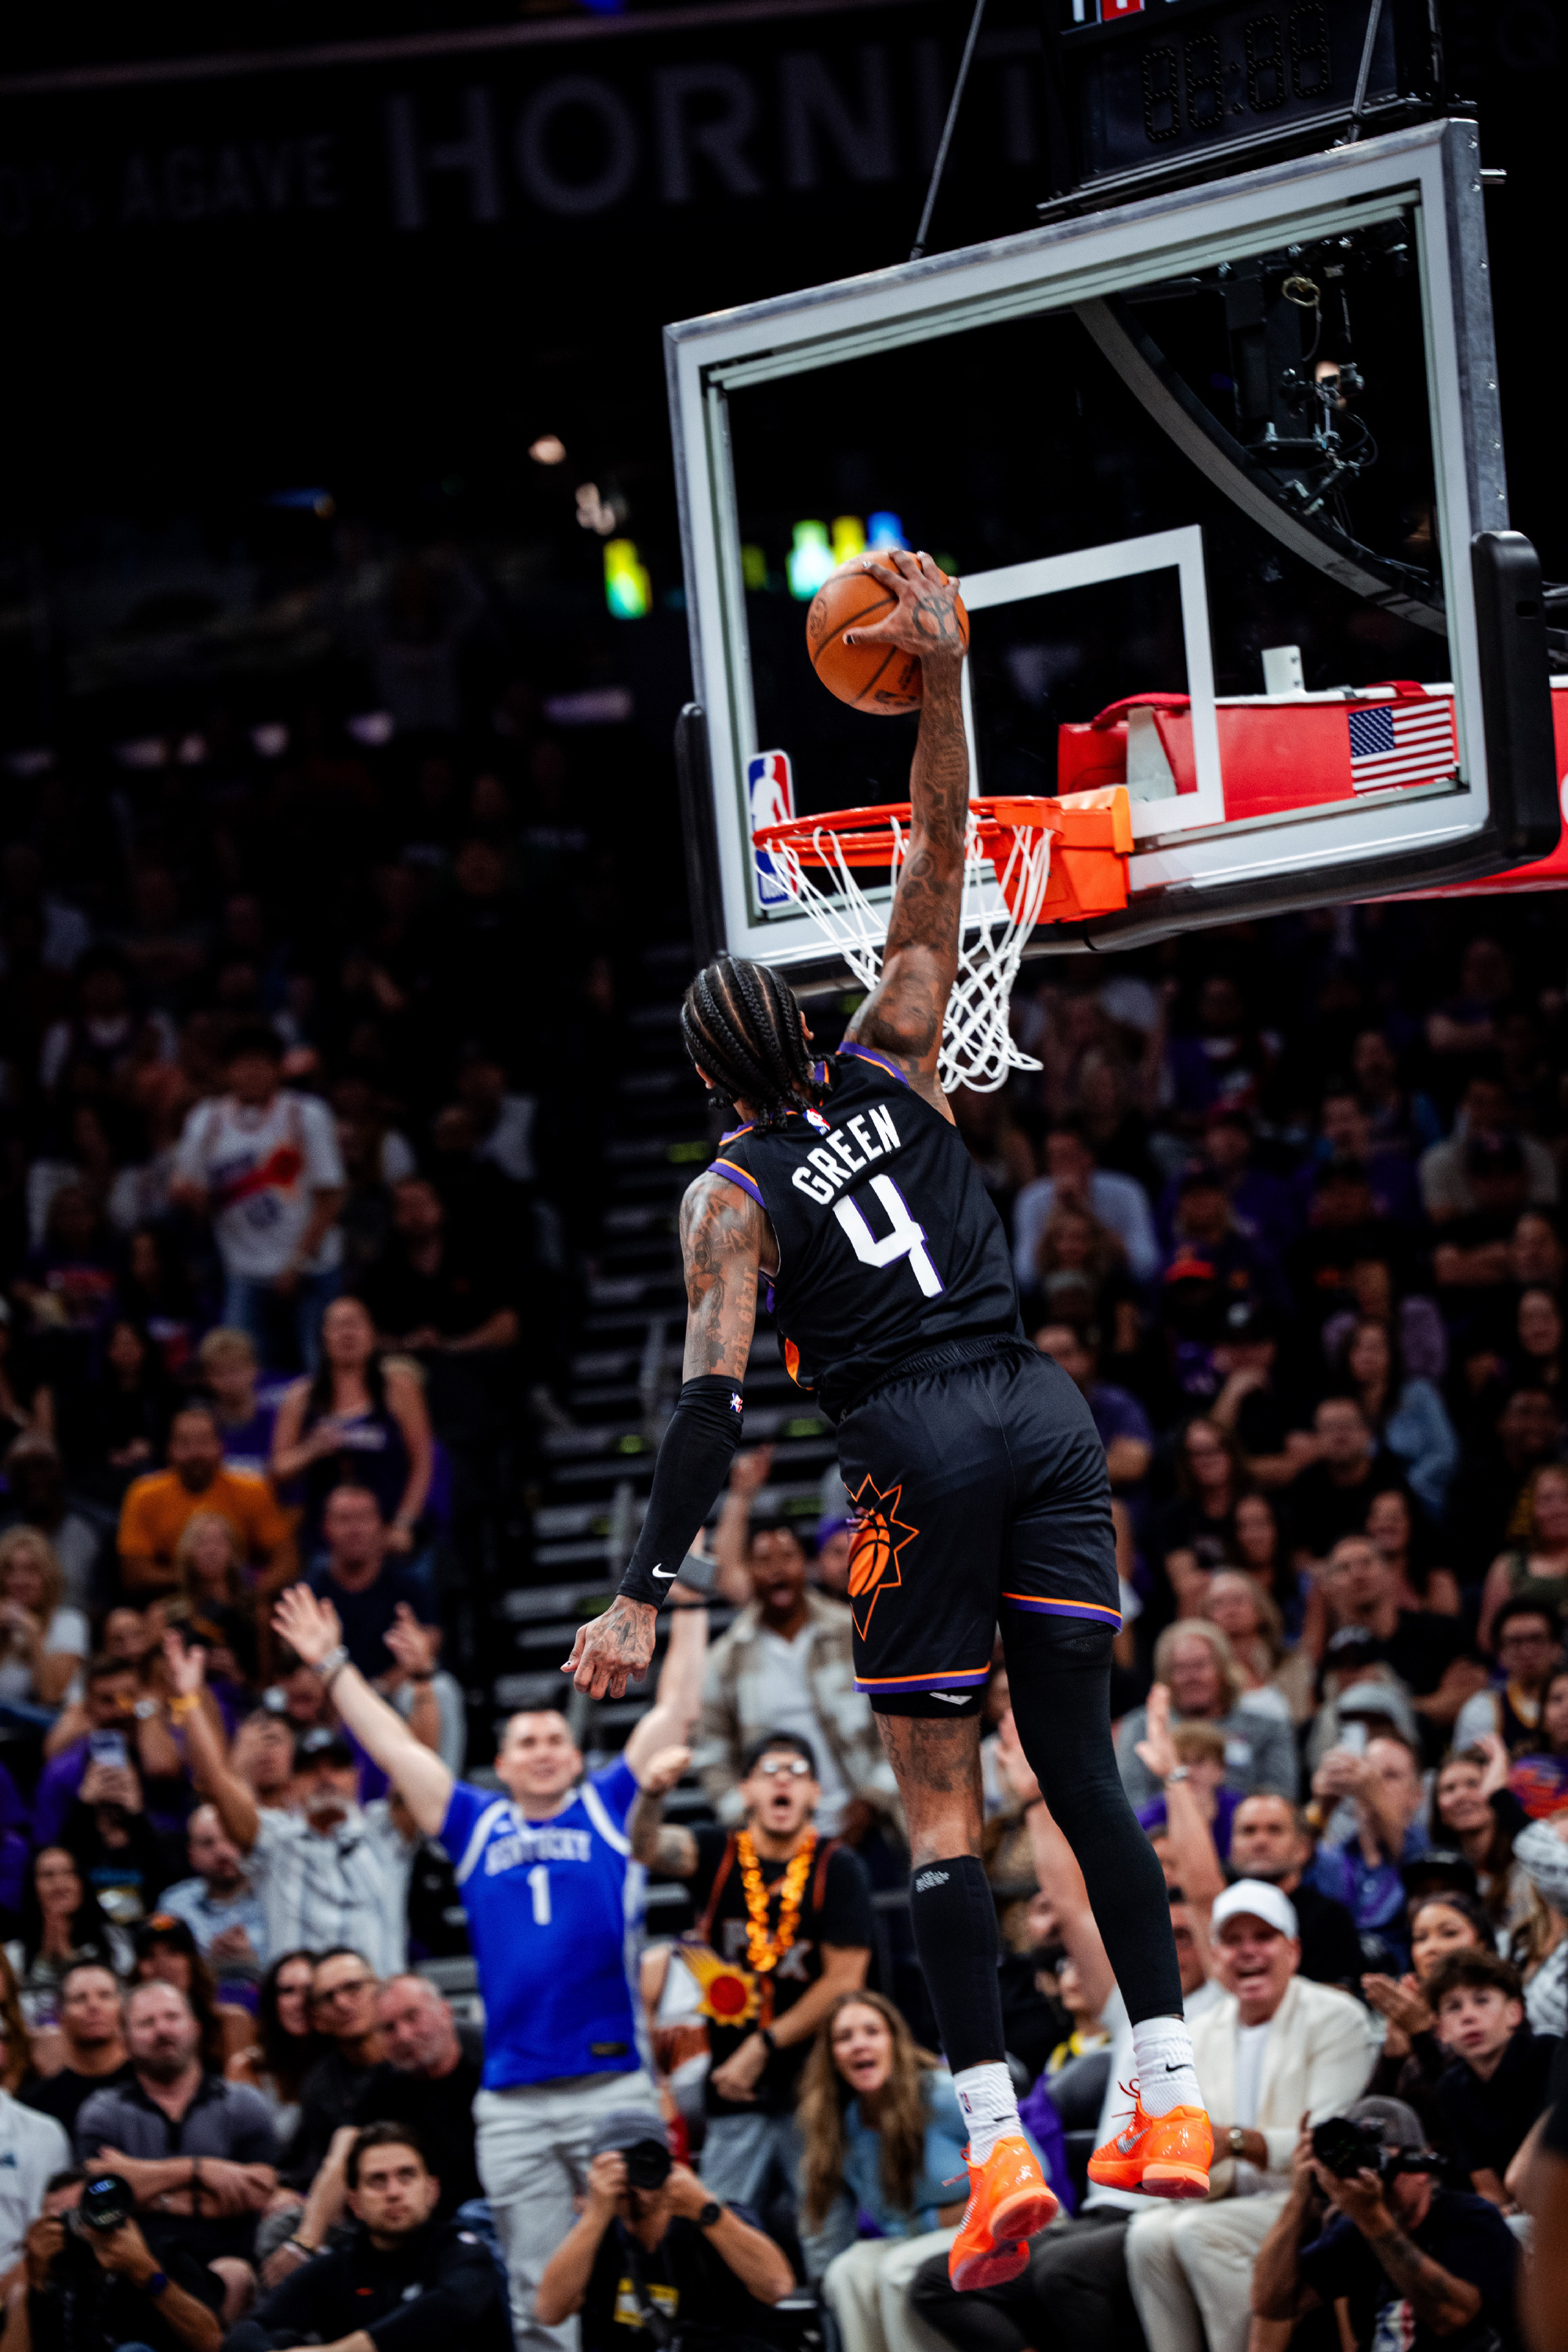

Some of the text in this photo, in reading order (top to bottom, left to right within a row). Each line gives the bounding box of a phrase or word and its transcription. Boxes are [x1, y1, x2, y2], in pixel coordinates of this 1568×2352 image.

[118, 128, 347, 230] AGAVE
[378, 24, 1044, 237] HORNIT
[792, 1104, 902, 1205] GREEN
[833, 1174, 946, 1298] 4
[527, 1864, 552, 1926] 1
